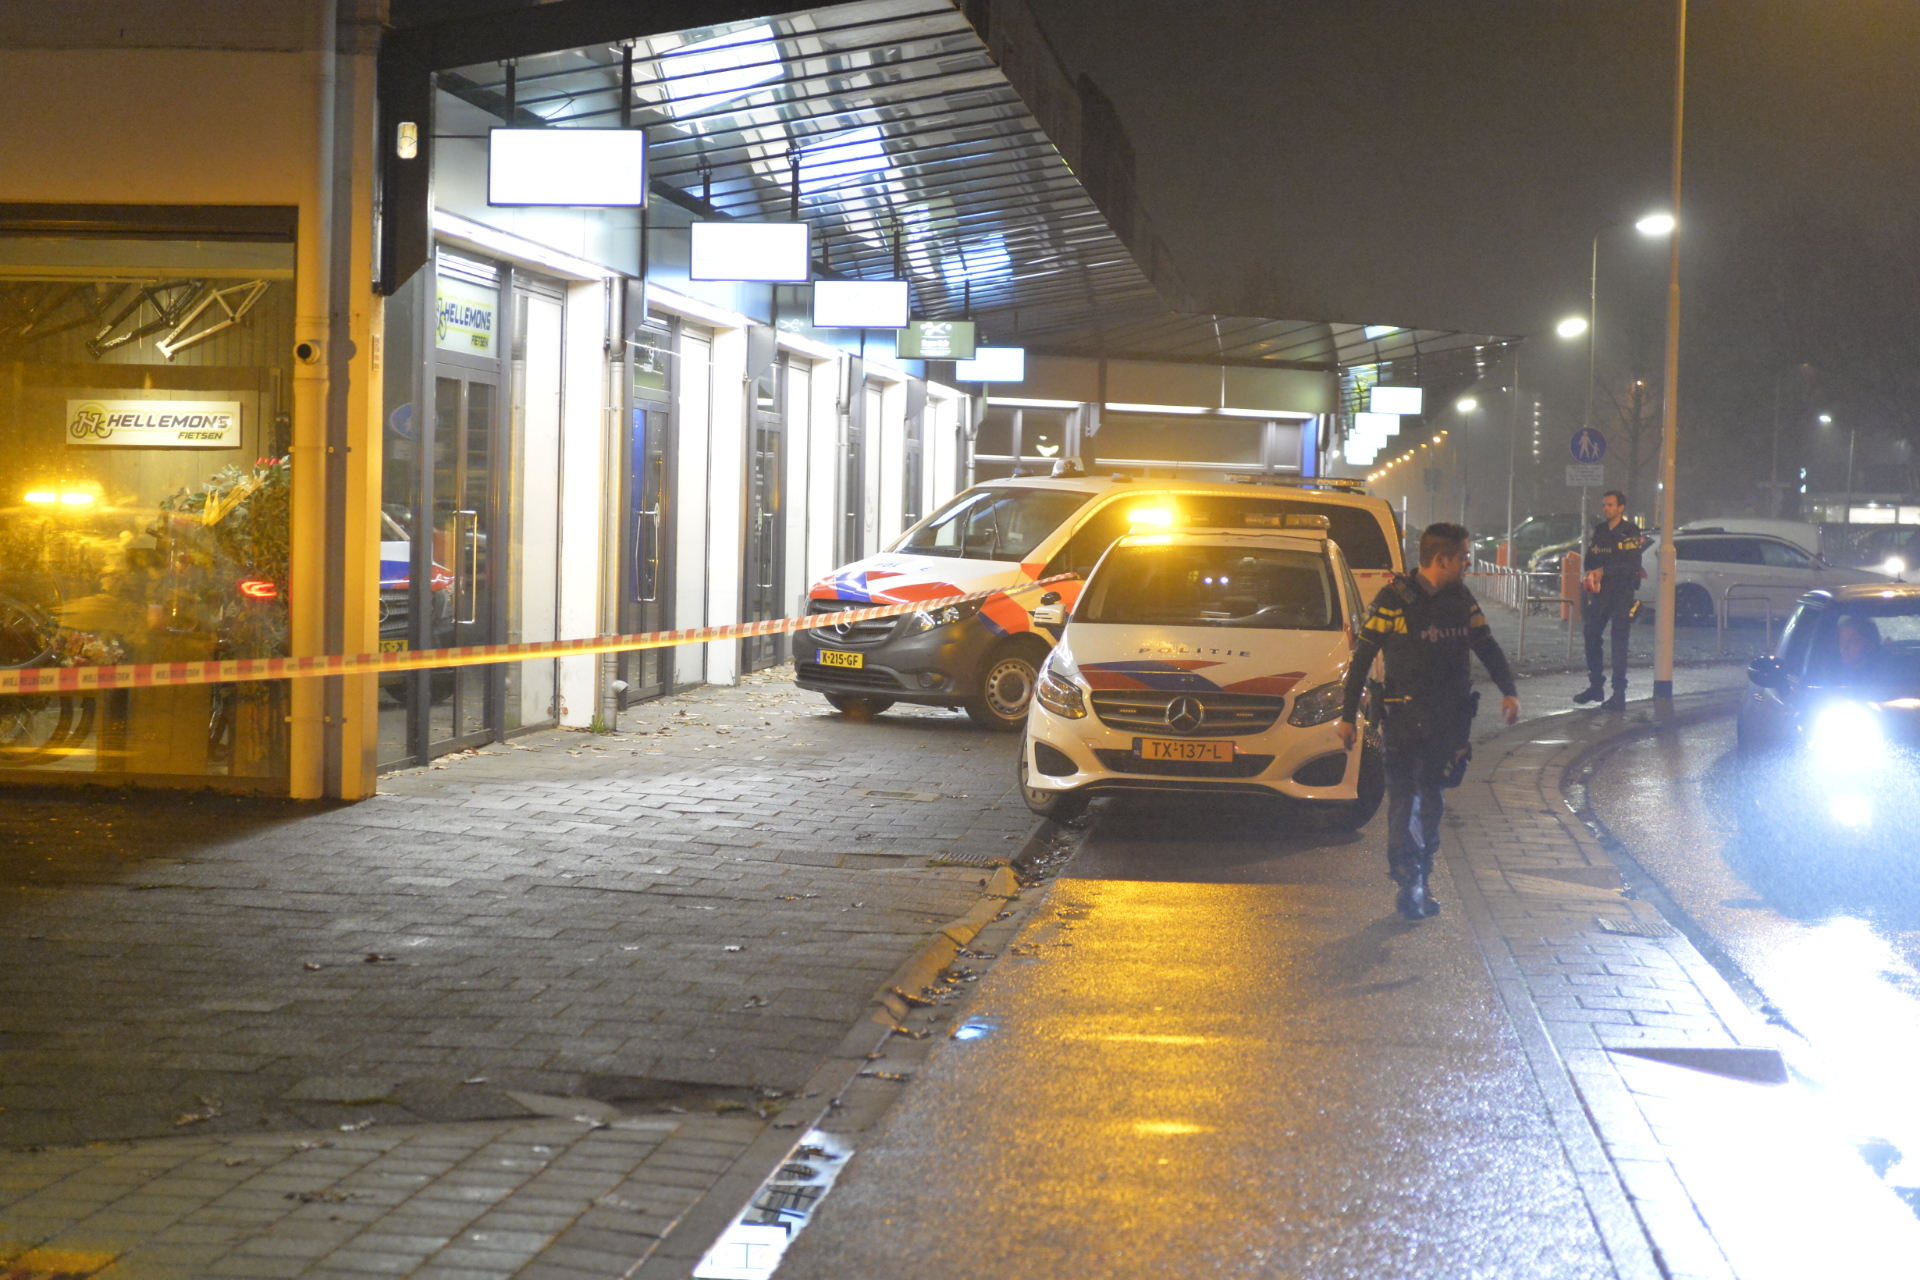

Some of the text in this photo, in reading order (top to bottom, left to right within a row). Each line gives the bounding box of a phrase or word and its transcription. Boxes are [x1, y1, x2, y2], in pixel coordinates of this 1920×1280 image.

[445, 302, 491, 330] HELLEMONS
[106, 414, 231, 429] HELLEMONS
[177, 432, 224, 440] FIETSEN
[822, 651, 859, 666] K-215-GF
[1138, 647, 1251, 658] POLITIE
